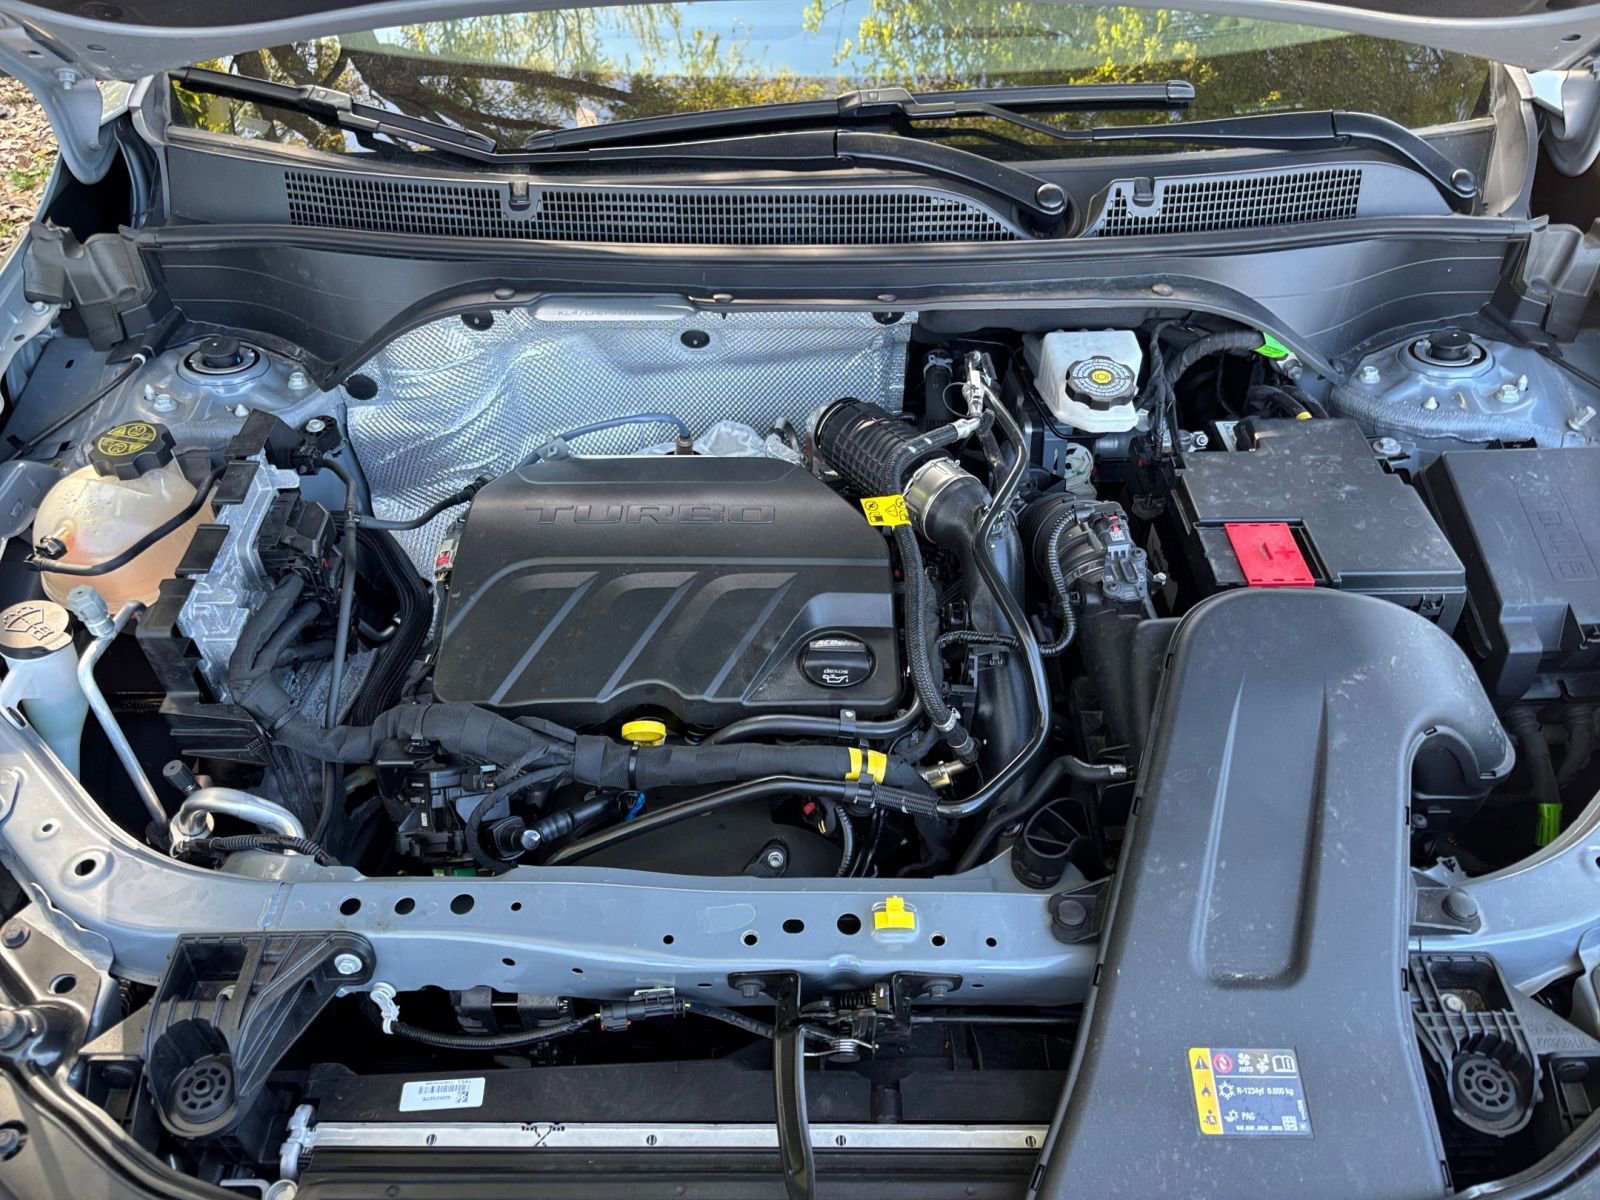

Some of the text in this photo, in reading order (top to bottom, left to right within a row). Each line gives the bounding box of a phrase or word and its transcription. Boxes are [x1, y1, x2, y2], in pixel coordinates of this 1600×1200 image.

[525, 504, 776, 524] TURBO
[815, 639, 860, 647] ACDelco
[1236, 1087, 1264, 1096] R-1234yf
[1285, 1087, 1294, 1096] kg
[1241, 1112, 1255, 1120] PAG
